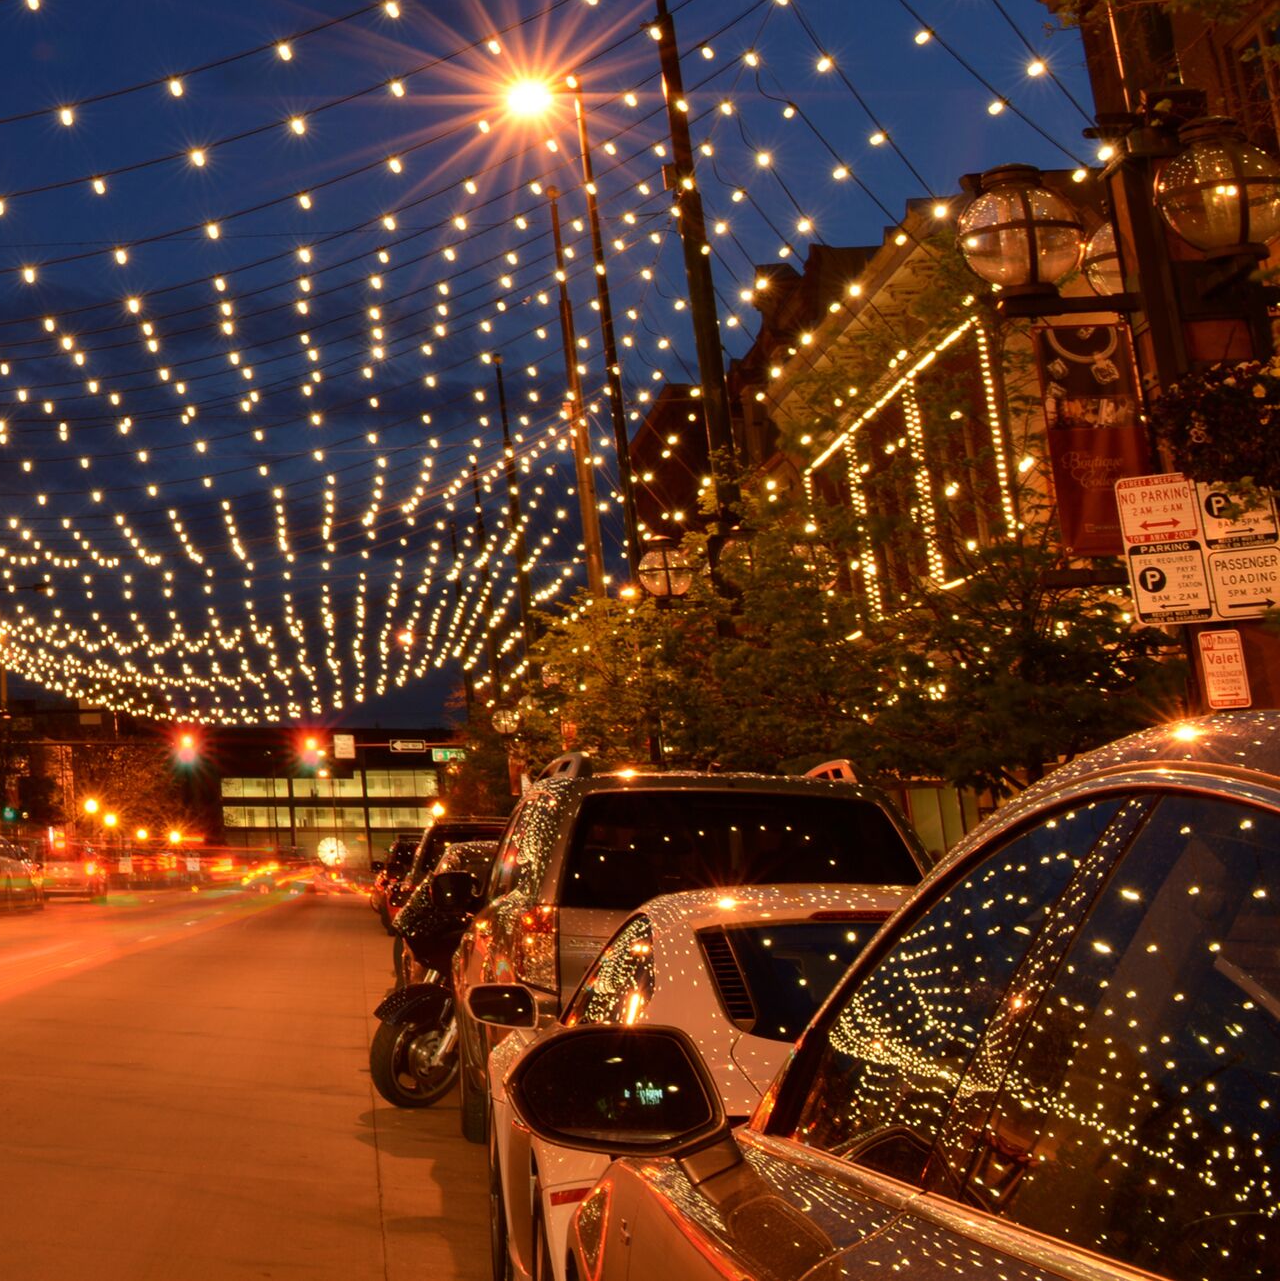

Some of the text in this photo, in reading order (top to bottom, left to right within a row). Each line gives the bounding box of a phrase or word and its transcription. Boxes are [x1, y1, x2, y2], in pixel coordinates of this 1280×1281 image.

[1120, 487, 1189, 505] NO PARKING
[1140, 542, 1190, 554] PARKING
[1139, 555, 1194, 566] FEE REQUIRED
[1215, 555, 1278, 571] PASSENGER
[1178, 581, 1203, 589] STATION
[1221, 571, 1277, 586] LOADING
[1206, 652, 1240, 665] Valet
